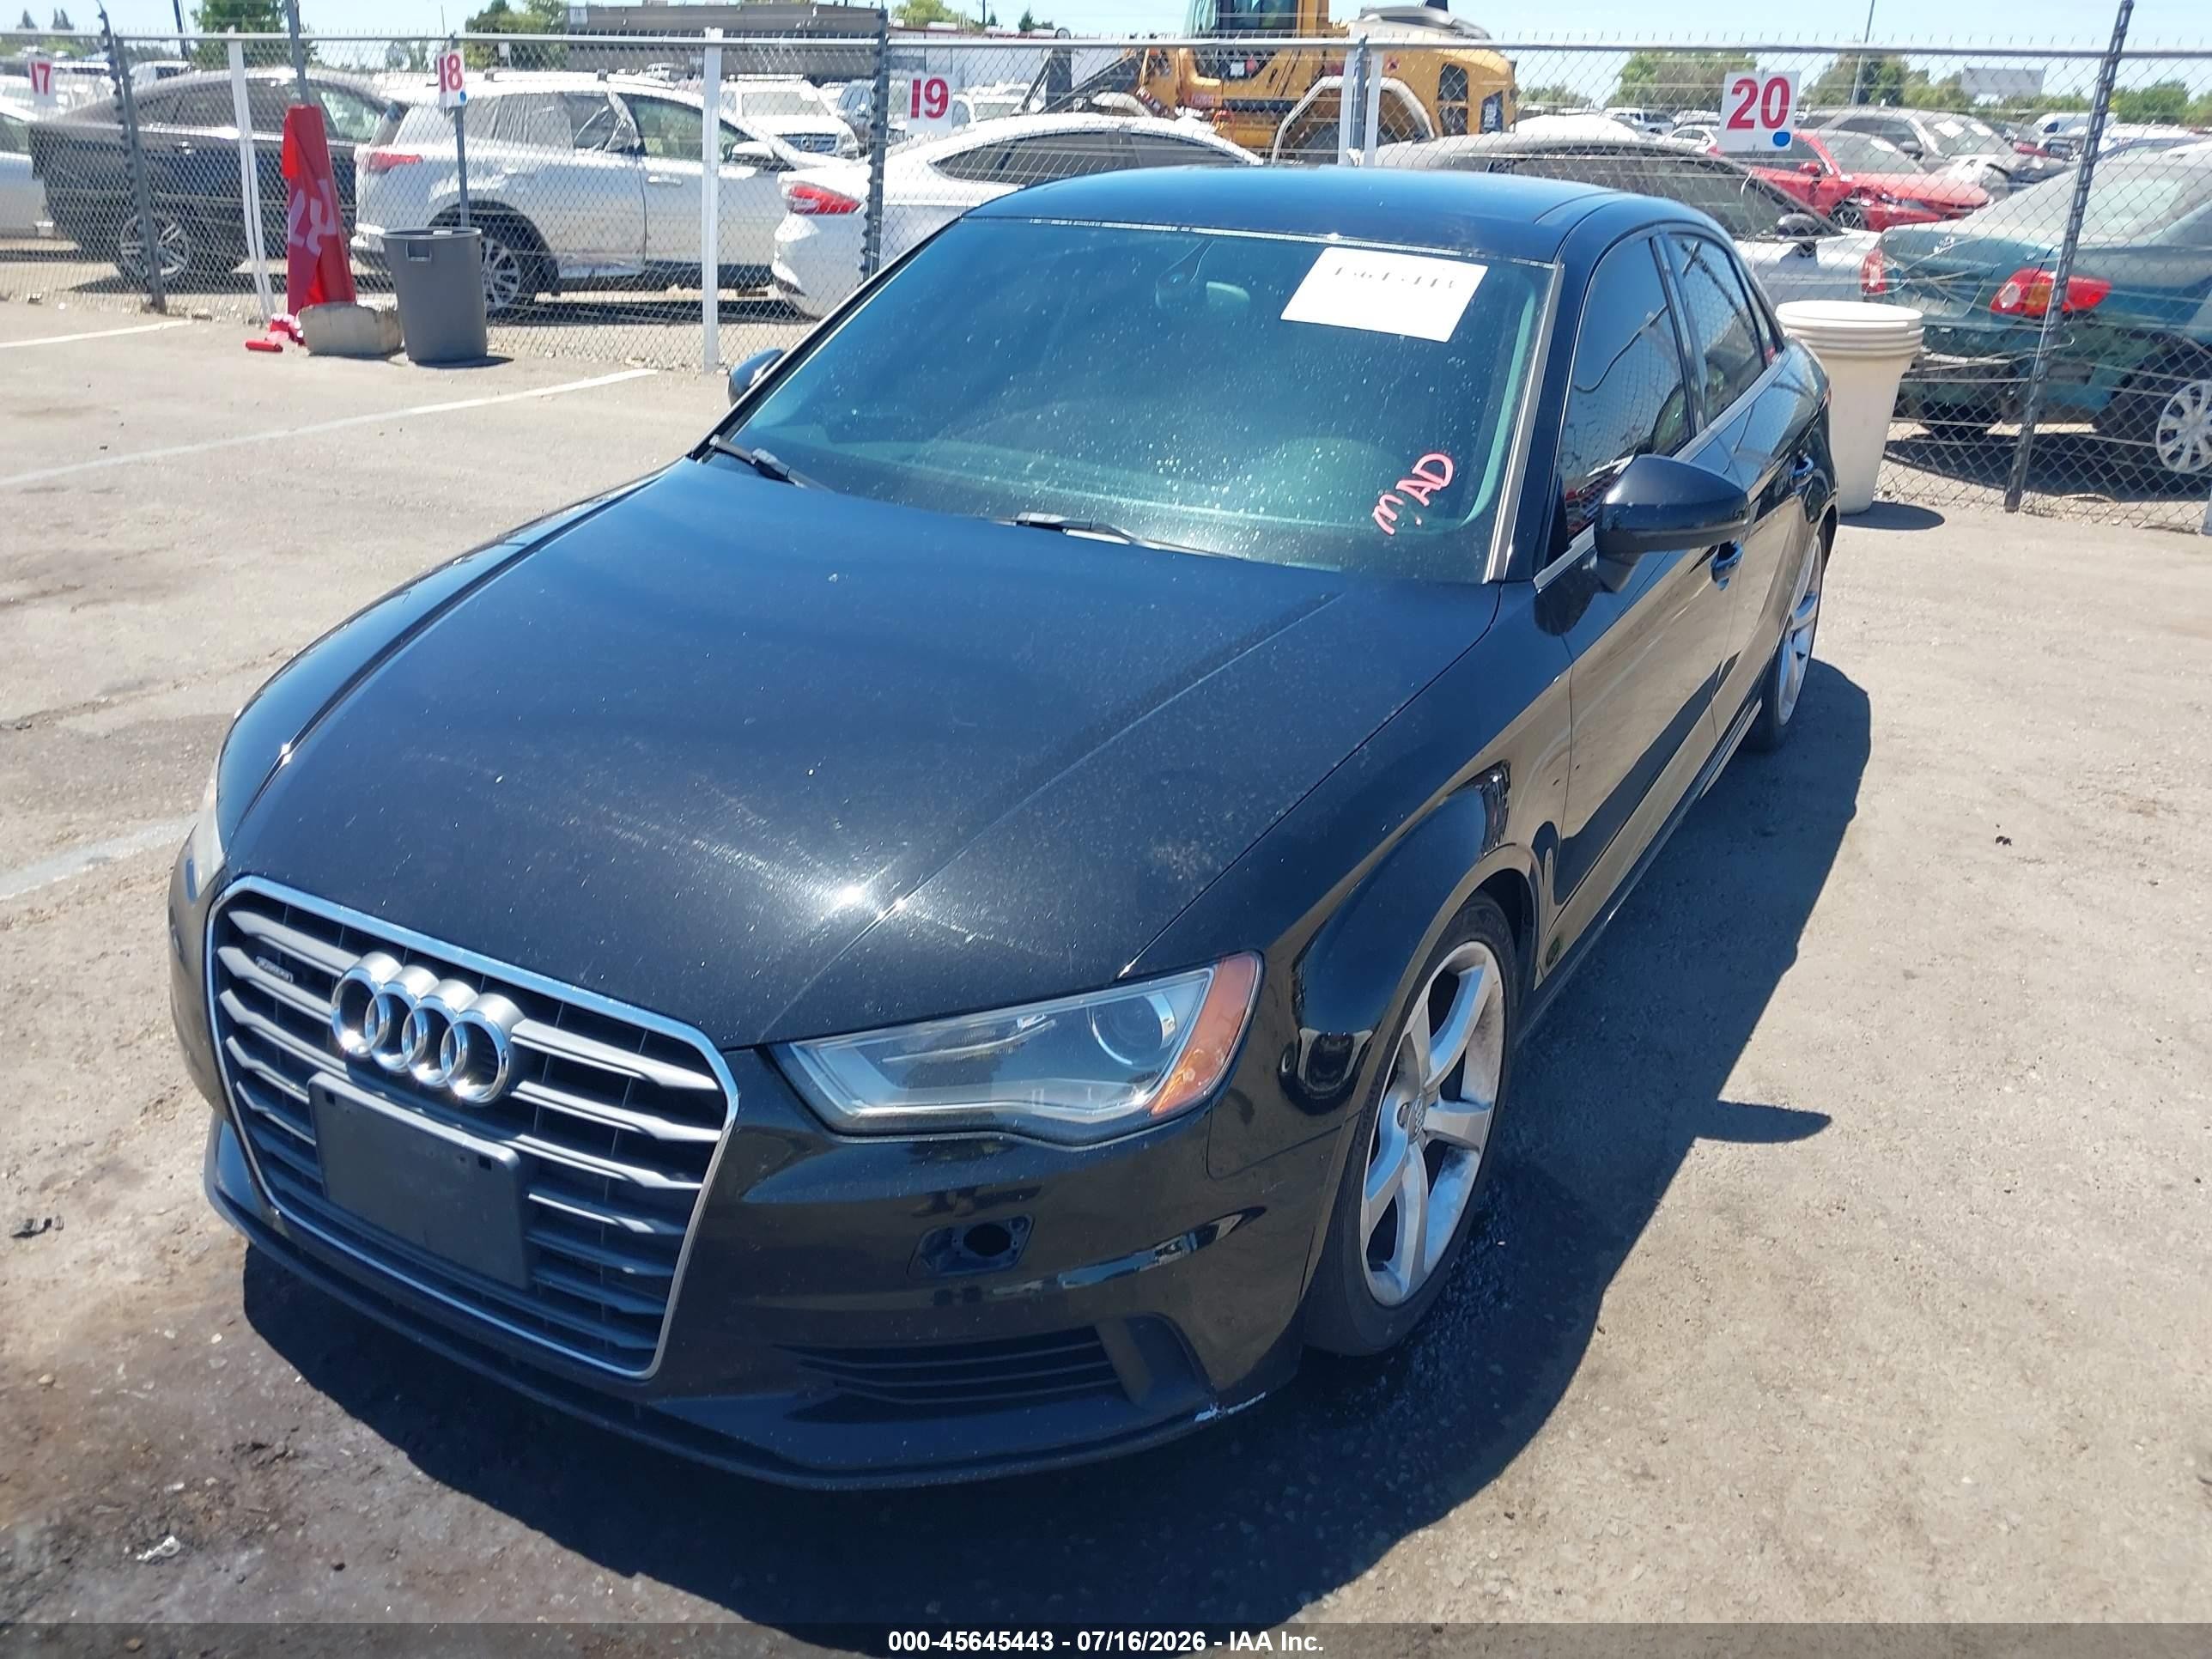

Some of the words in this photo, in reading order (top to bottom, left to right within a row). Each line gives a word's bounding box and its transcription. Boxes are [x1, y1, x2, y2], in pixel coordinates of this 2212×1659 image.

[31, 62, 51, 95] 17
[439, 55, 463, 93] 18
[911, 78, 949, 118] 19
[1727, 76, 1790, 130] 20
